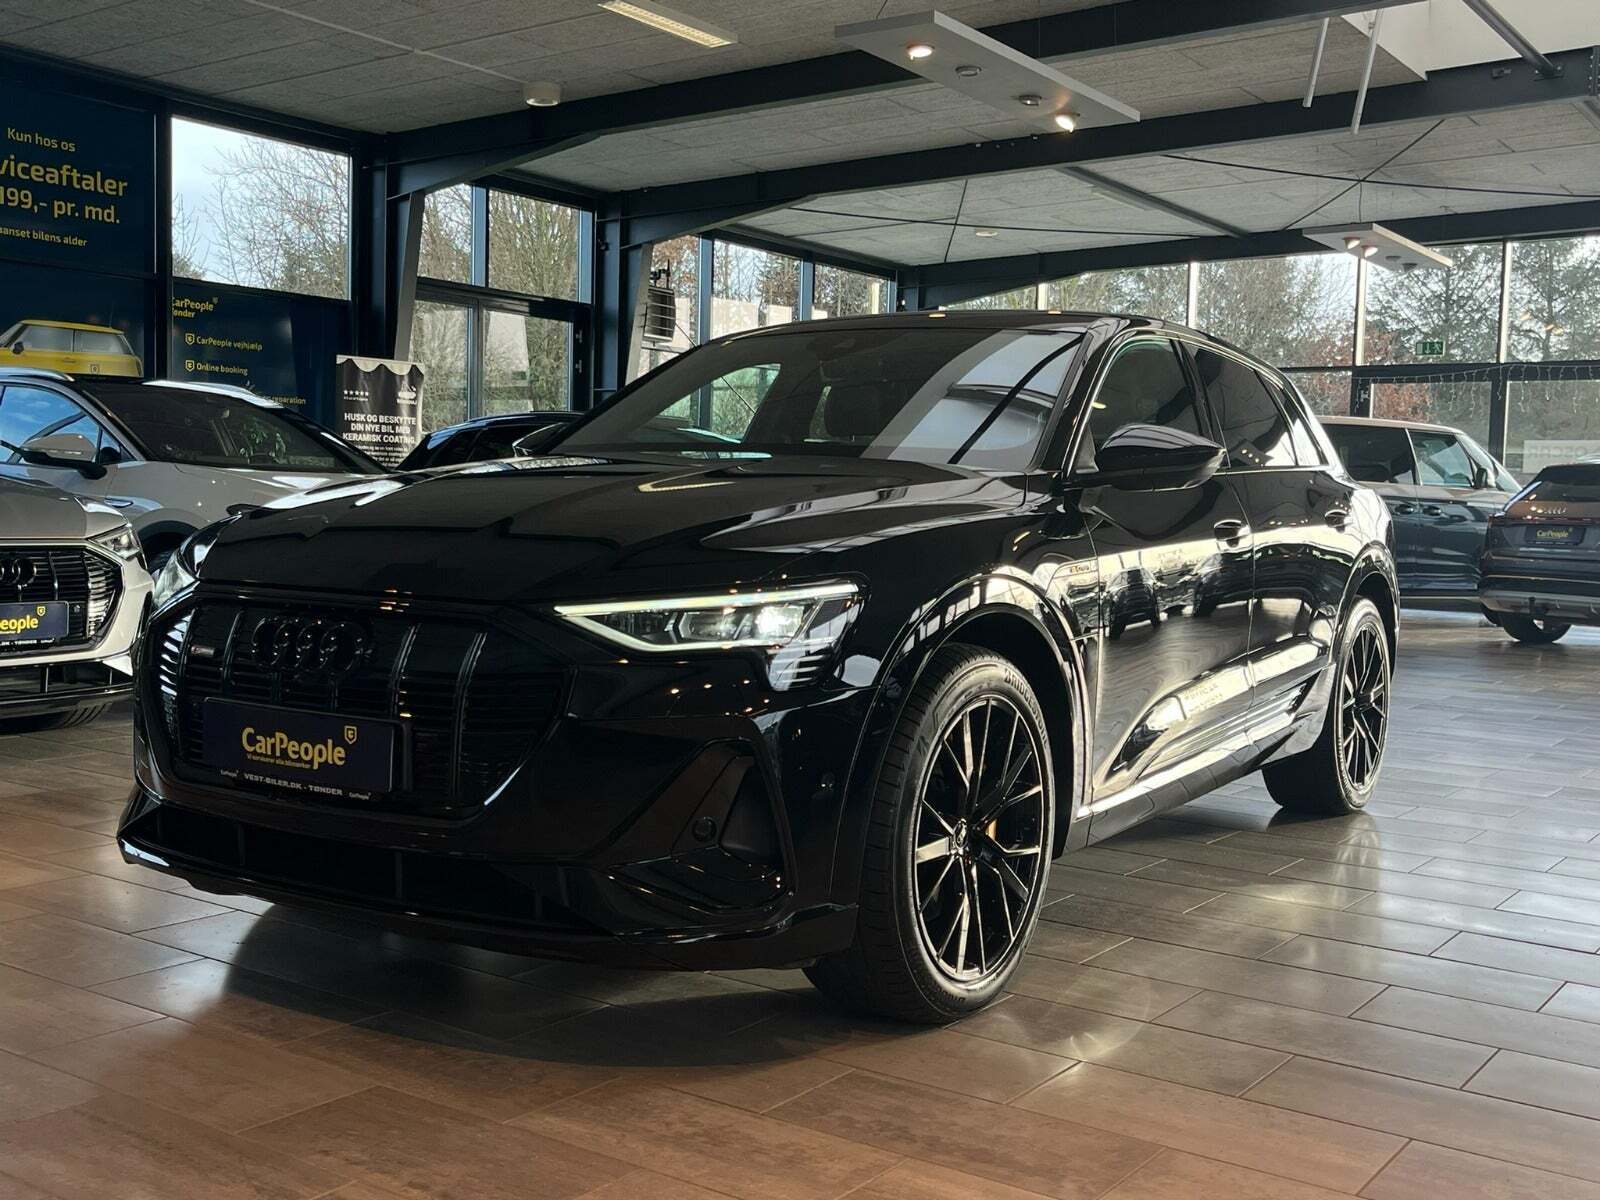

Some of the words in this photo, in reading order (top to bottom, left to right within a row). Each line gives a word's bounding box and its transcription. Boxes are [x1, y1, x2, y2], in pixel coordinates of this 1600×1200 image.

[7, 127, 32, 143] Kun
[35, 132, 58, 149] hos
[60, 140, 76, 152] os
[53, 199, 79, 218] pr.
[84, 204, 120, 224] md.
[32, 230, 62, 243] bilens
[63, 235, 88, 247] alder
[196, 336, 232, 348] CarPeople
[196, 362, 220, 372] Online
[220, 365, 249, 376] booking
[344, 412, 366, 422] HUSK
[366, 414, 378, 423] OG
[379, 415, 417, 426] BESKYTTE
[350, 423, 364, 432] DIN
[365, 424, 381, 433] NYE
[381, 425, 395, 434] BIL
[342, 432, 382, 443] KERAMISK
[241, 727, 346, 770] CarPeople
